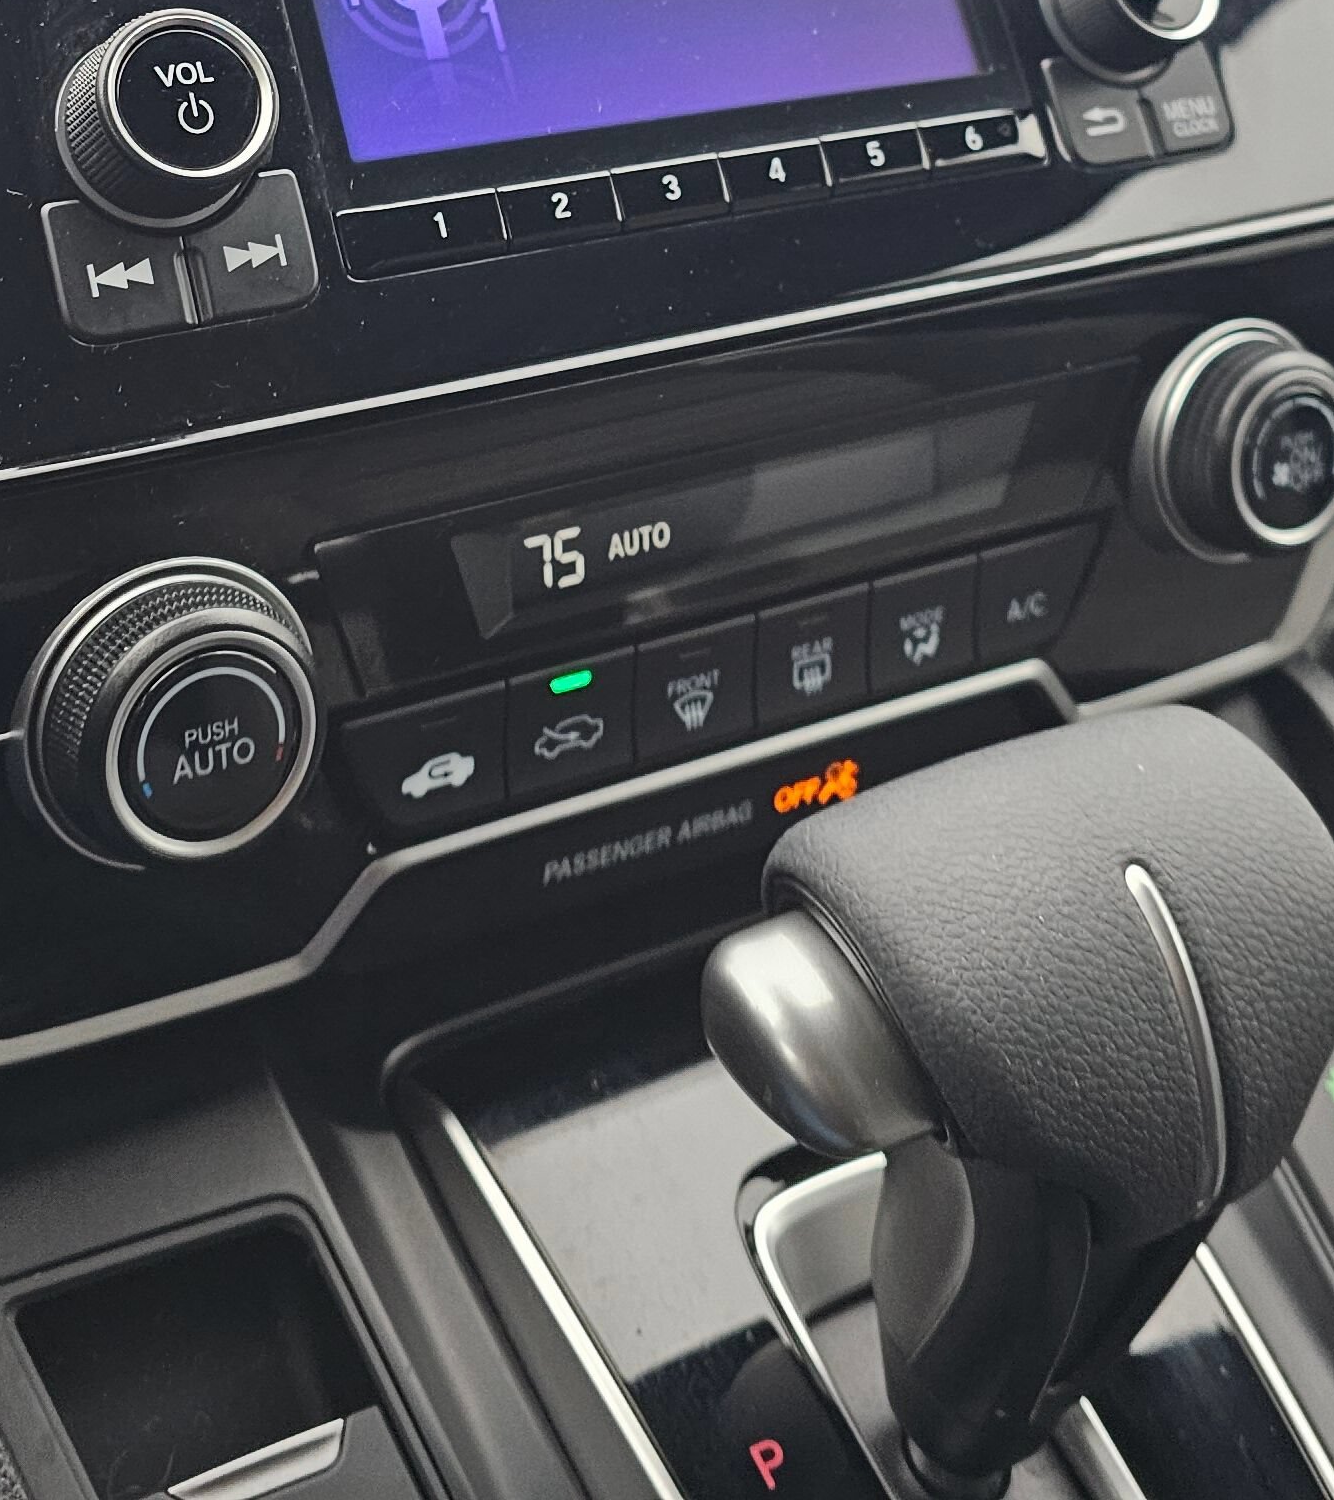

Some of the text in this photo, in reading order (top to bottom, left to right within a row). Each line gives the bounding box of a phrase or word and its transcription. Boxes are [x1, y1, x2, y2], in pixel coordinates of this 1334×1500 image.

[154, 60, 215, 87] VOL
[1164, 97, 1215, 119] MENU
[965, 125, 983, 150] 6
[1174, 118, 1218, 137] CLOCK
[866, 141, 886, 167] 5
[769, 157, 786, 182] 4
[662, 175, 682, 200] 3
[552, 193, 571, 219] 2
[434, 212, 448, 237] 1
[525, 522, 671, 588] 75 AUTO
[899, 606, 945, 630] MODE
[1007, 593, 1046, 622] A/C
[791, 637, 833, 660] REAR
[667, 669, 720, 698] FRONT
[184, 718, 238, 746] PUSH
[174, 738, 255, 784] AUTO
[543, 825, 671, 885] PASSENGER
[677, 801, 753, 848] AIRBAG
[750, 1439, 785, 1490] P
